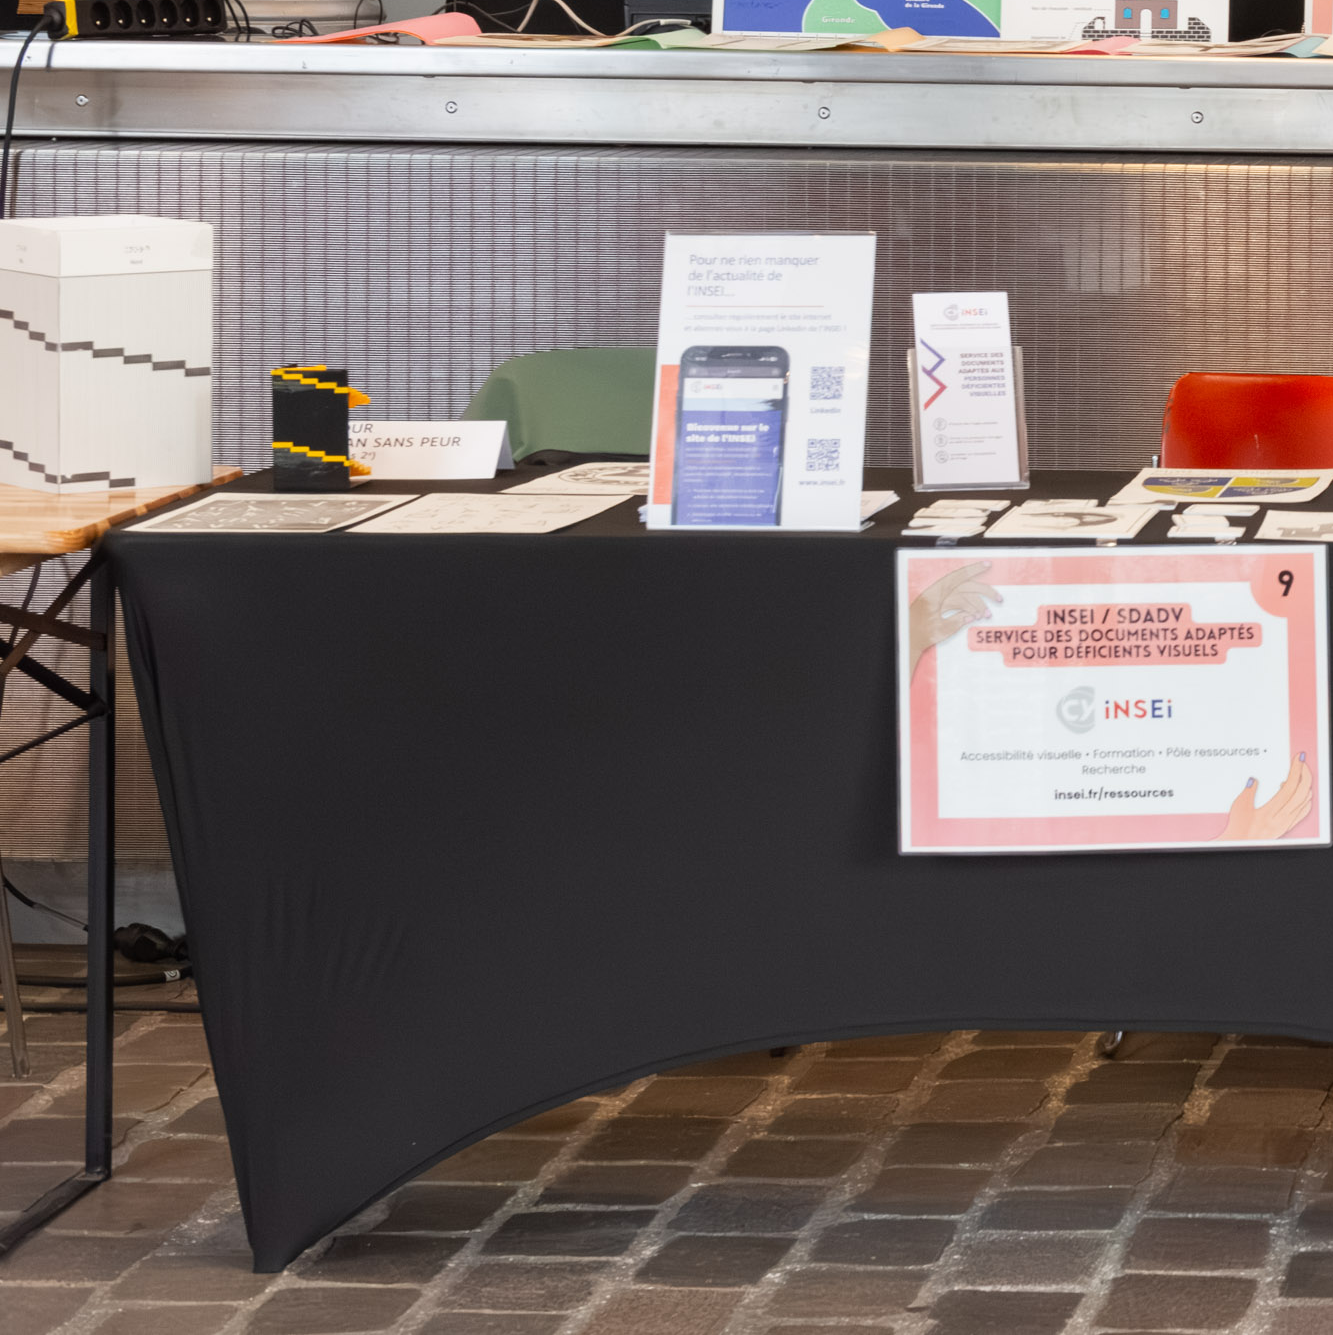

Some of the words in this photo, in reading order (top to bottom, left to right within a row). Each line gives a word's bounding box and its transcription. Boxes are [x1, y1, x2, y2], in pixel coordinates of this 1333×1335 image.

[689, 255, 717, 265] Pour
[720, 257, 735, 265] ne
[739, 255, 762, 265] rien
[765, 257, 819, 268] manquer
[688, 270, 703, 281] de
[706, 270, 764, 281] l'actualité
[767, 271, 783, 281] de
[348, 438, 367, 447] AN
[373, 437, 414, 448] SANS
[420, 436, 461, 447] PEUR
[1278, 569, 1294, 597] 9
[1047, 609, 1094, 625] INSEI
[1101, 608, 1110, 624] /
[1116, 607, 1184, 624] SDADV
[976, 630, 1037, 643] SERVICE
[1044, 629, 1072, 643] DES
[1079, 627, 1178, 643] DOCUMENTS
[1184, 624, 1254, 641] ADAPTÉS
[1012, 646, 1057, 660] POUR
[1064, 643, 1150, 659] DÉFICIENTS
[1157, 644, 1218, 658] VISUELS
[961, 749, 1034, 762] Accessibilité
[1037, 748, 1082, 761] visuelle
[1093, 747, 1155, 760] Formation
[1166, 746, 1191, 758] Pôle
[1194, 747, 1260, 758] ressources
[1082, 764, 1146, 776] Recherche
[1054, 787, 1174, 801] insei.fr/ressources
